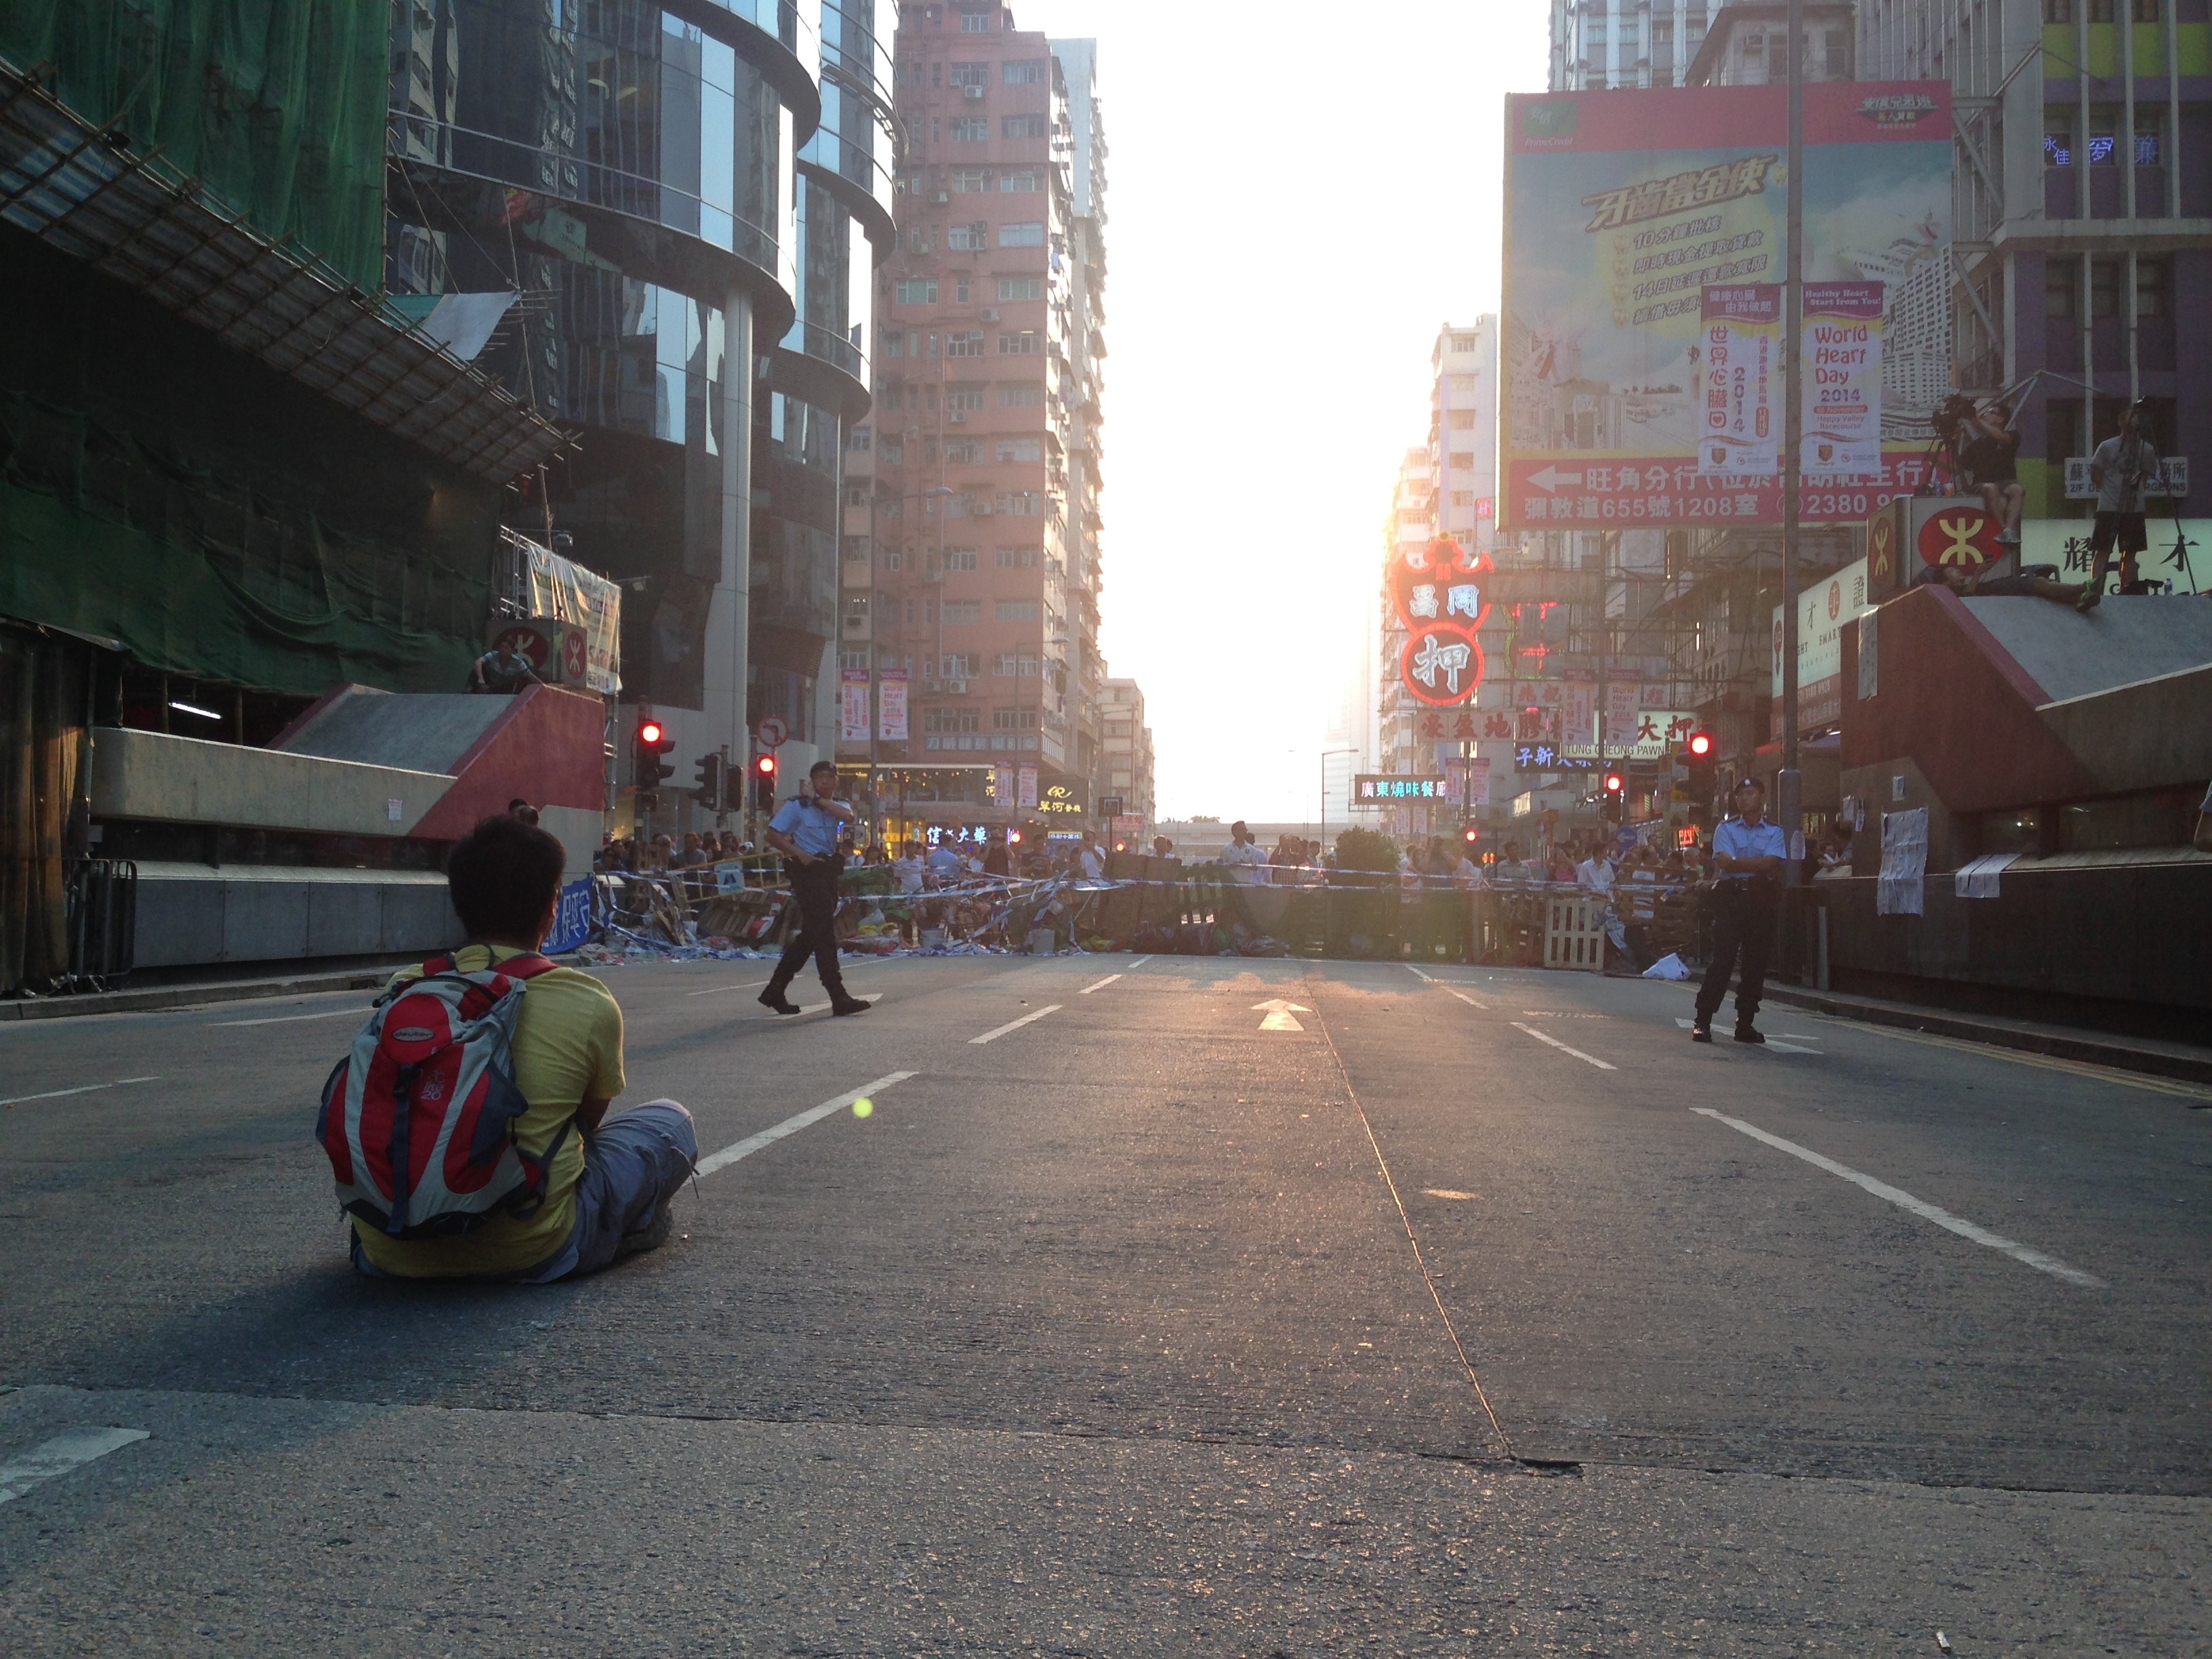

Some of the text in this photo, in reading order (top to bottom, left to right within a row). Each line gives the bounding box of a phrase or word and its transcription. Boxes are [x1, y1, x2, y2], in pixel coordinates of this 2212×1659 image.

[1580, 156, 1778, 233] 牙齒當金使
[1633, 295, 1701, 325] 續借毋須
[1815, 325, 1868, 344] World
[1816, 347, 1867, 365] Heart
[1815, 367, 1849, 386] Day
[1820, 388, 1861, 402] 2014
[1817, 415, 1865, 424] Happy Valley
[2070, 485, 2084, 493] 2/F
[2144, 483, 2186, 493] RGEONS
[1525, 494, 1759, 520] 彌敦道655號1208室
[1807, 494, 1867, 514] 2380
[1412, 634, 1471, 695] 押
[1637, 715, 1694, 741] 大押
[1567, 745, 1591, 754] TUNG
[1637, 746, 1665, 755] PAWN
[1361, 780, 1446, 798] 廣東燒味餐廳
[926, 825, 987, 845] 信大藥
[421, 1090, 442, 1101] 20
